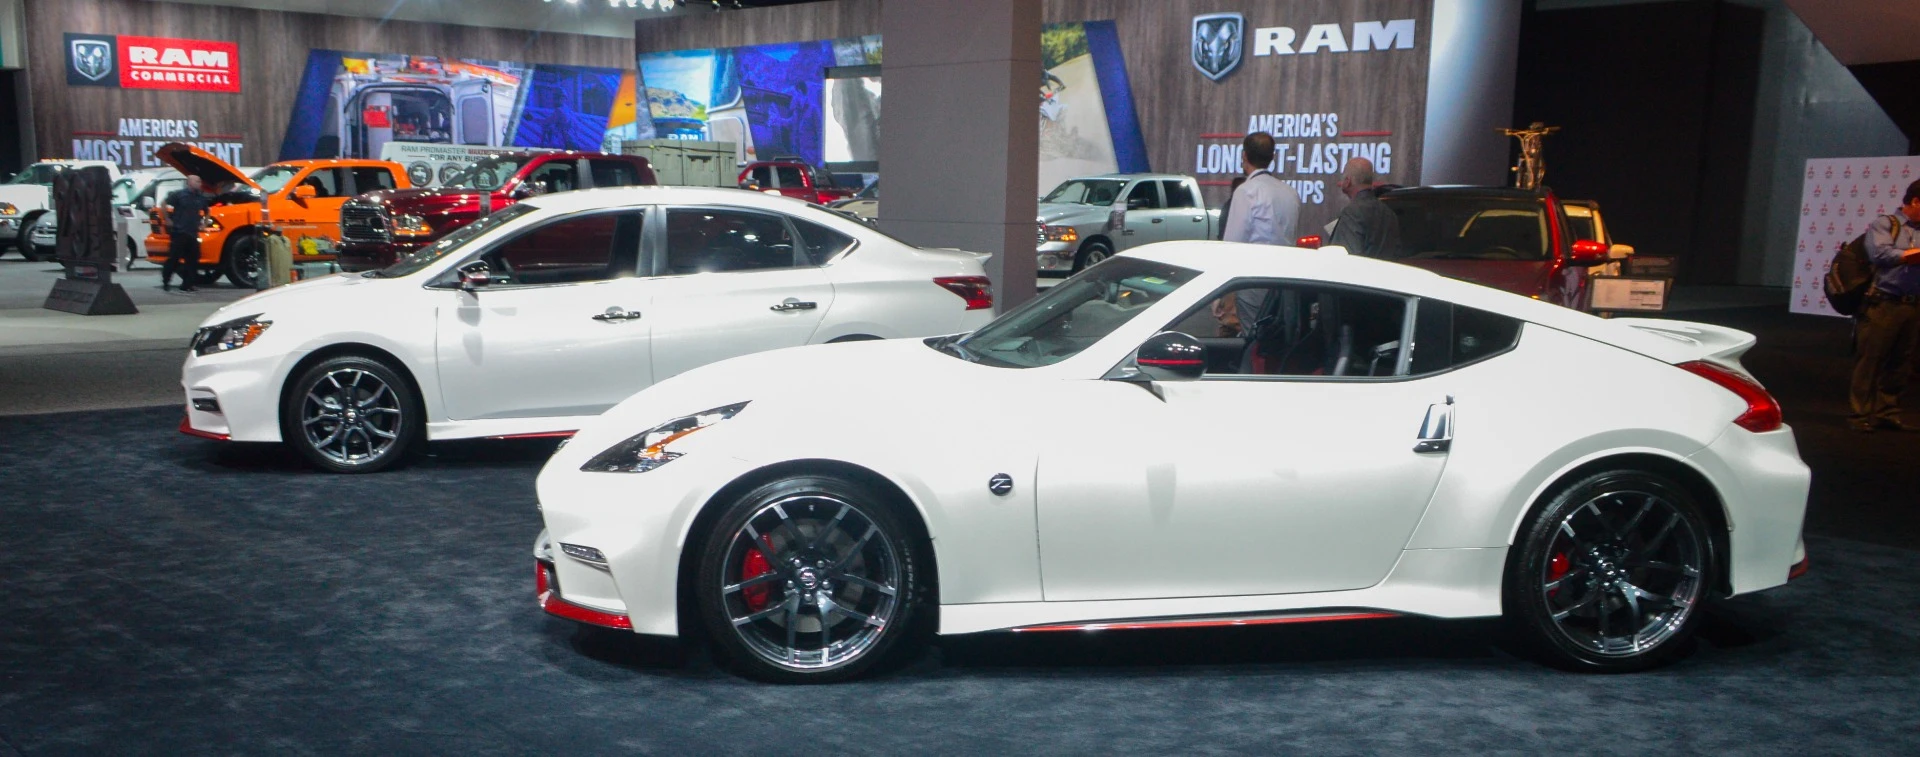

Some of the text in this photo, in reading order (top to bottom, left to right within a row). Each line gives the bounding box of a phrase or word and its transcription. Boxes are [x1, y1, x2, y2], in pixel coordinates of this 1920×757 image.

[1254, 19, 1415, 56] RAM
[129, 46, 229, 68] RAM
[130, 70, 230, 84] COMMERCIAL
[118, 118, 199, 138] AMERICA'S
[1247, 113, 1338, 138] AMERICA'S
[72, 138, 134, 167] MOST
[401, 145, 419, 153] RAM
[420, 146, 466, 155] PROMASTER
[1196, 142, 1391, 174] LONGT-LASTING
